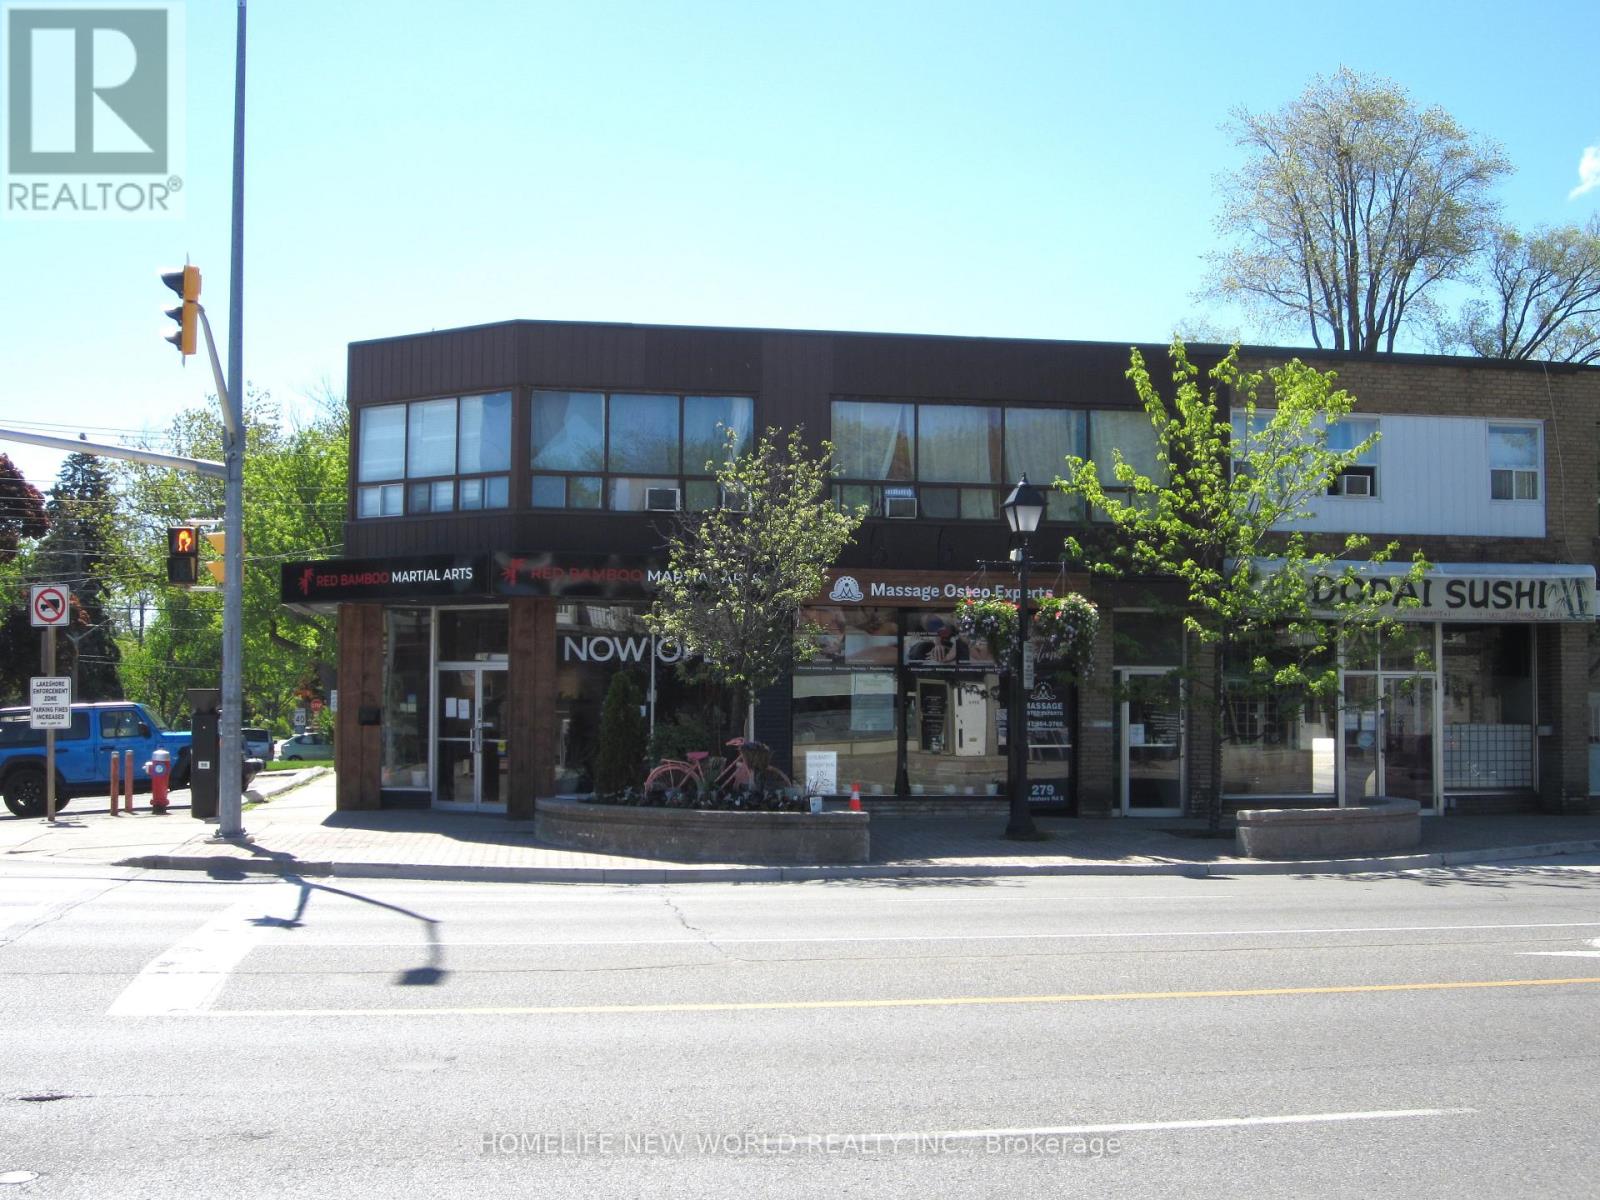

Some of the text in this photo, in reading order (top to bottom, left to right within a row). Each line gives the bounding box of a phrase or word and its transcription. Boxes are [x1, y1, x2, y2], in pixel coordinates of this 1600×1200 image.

[316, 567, 473, 587] RED BAMBOO MARTIAL ARTS
[530, 569, 762, 584] RED BAMBOO MARIA ARS
[870, 582, 1054, 602] Massage Osteo Experts
[1445, 579, 1548, 609] SUSHI
[563, 636, 647, 662] NOW
[296, 715, 304, 723] 40
[1031, 784, 1055, 796] 279
